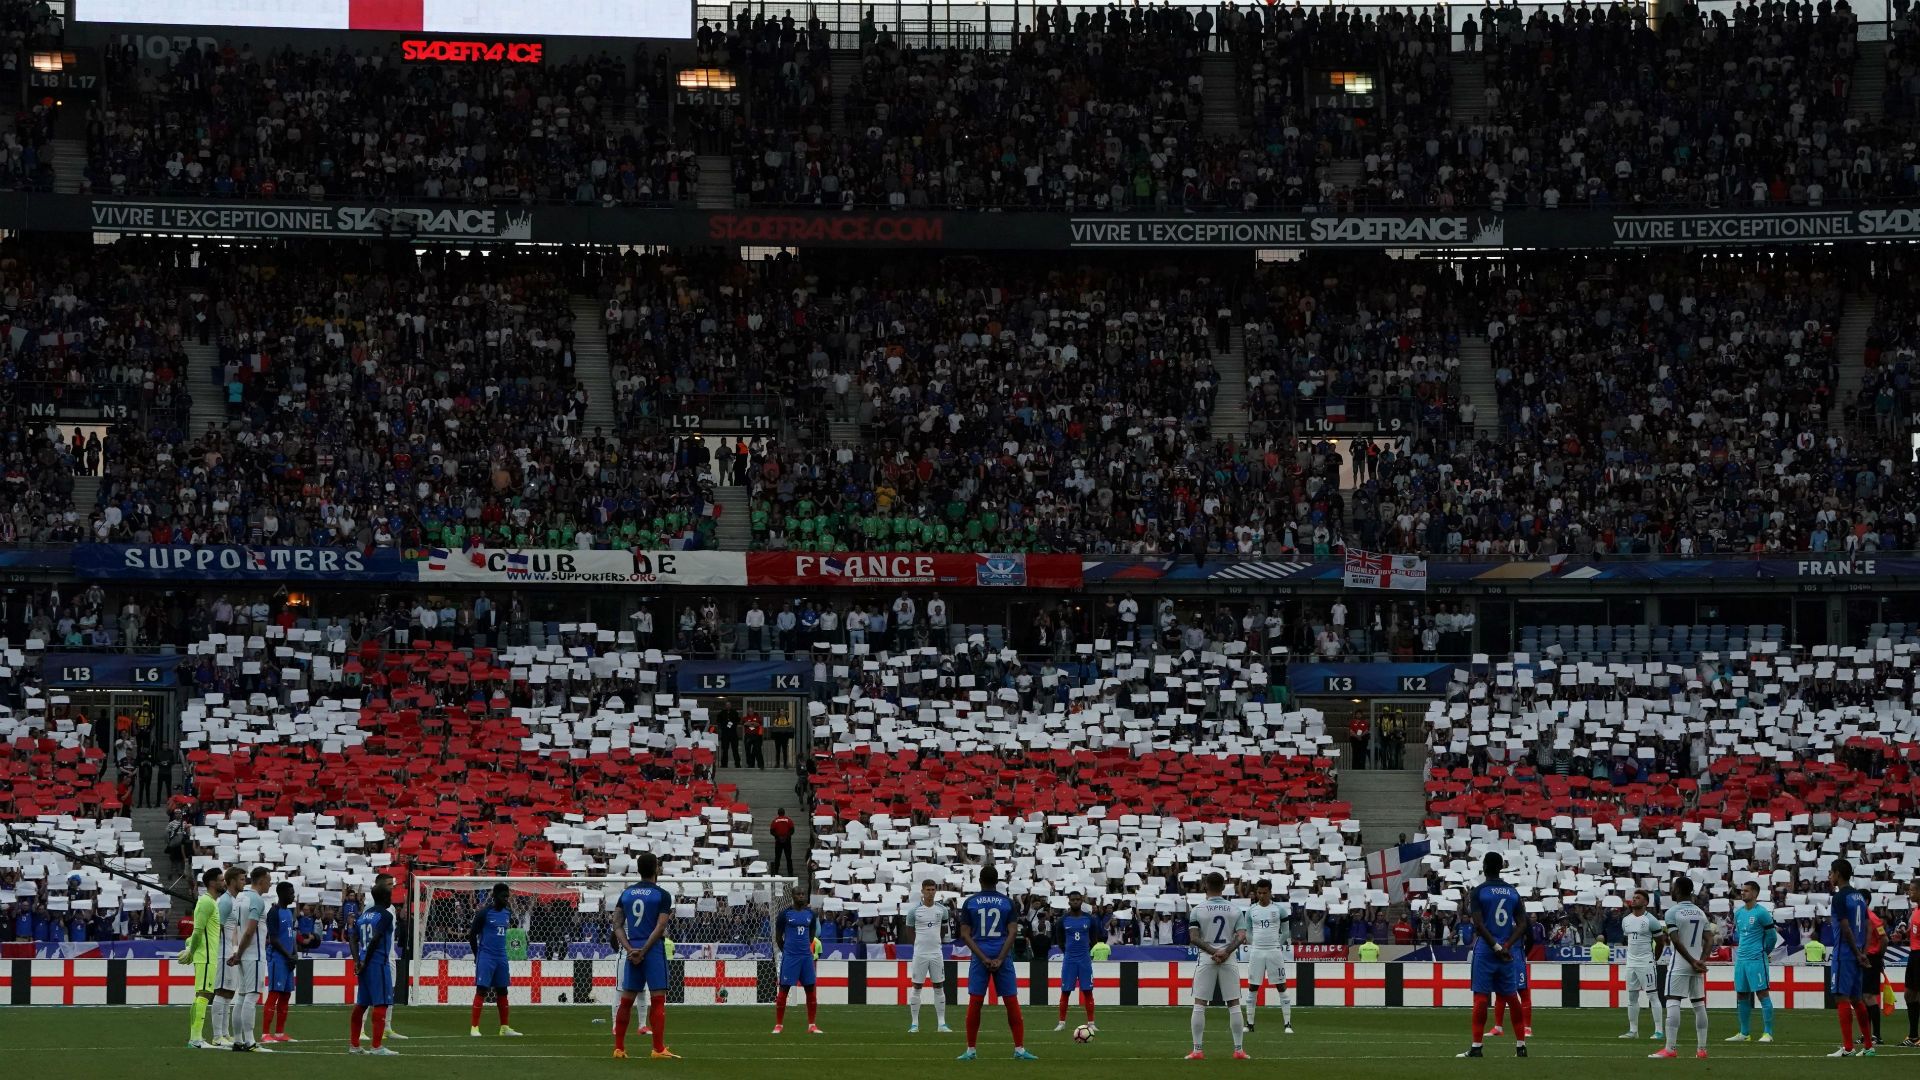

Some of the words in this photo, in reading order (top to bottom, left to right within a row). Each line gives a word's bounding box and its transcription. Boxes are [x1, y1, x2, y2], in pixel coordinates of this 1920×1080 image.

[92, 207, 154, 226] VIVRE
[161, 208, 333, 230] L'EXCEPTIONNEL
[709, 214, 944, 241] STADEFRANCE.COM
[1613, 220, 1675, 239] VIVRE
[1681, 216, 1854, 238] L'EXCEPTIONNEL
[1070, 224, 1131, 241] VIVRE
[1138, 224, 1306, 242] L'EXCEPTIONNEL
[1310, 217, 1468, 241] STADEFRANCE
[487, 552, 577, 573] CUB
[633, 554, 677, 575] DE
[1798, 559, 1876, 575] FRANCE
[63, 667, 91, 681] L13
[1491, 888, 1510, 896] POGBA
[632, 899, 645, 928] 9
[978, 908, 1002, 937] 12
[1495, 899, 1508, 927] 6
[1855, 905, 1861, 933] 4
[797, 926, 805, 936] 19
[1213, 915, 1227, 943] 2
[1259, 919, 1270, 929] 10
[1689, 919, 1700, 947] 7
[1074, 931, 1081, 942] 8
[1298, 945, 1343, 953] FRANCE
[1278, 966, 1287, 977] 10
[1519, 971, 1526, 983] 3
[1646, 973, 1654, 984] 11
